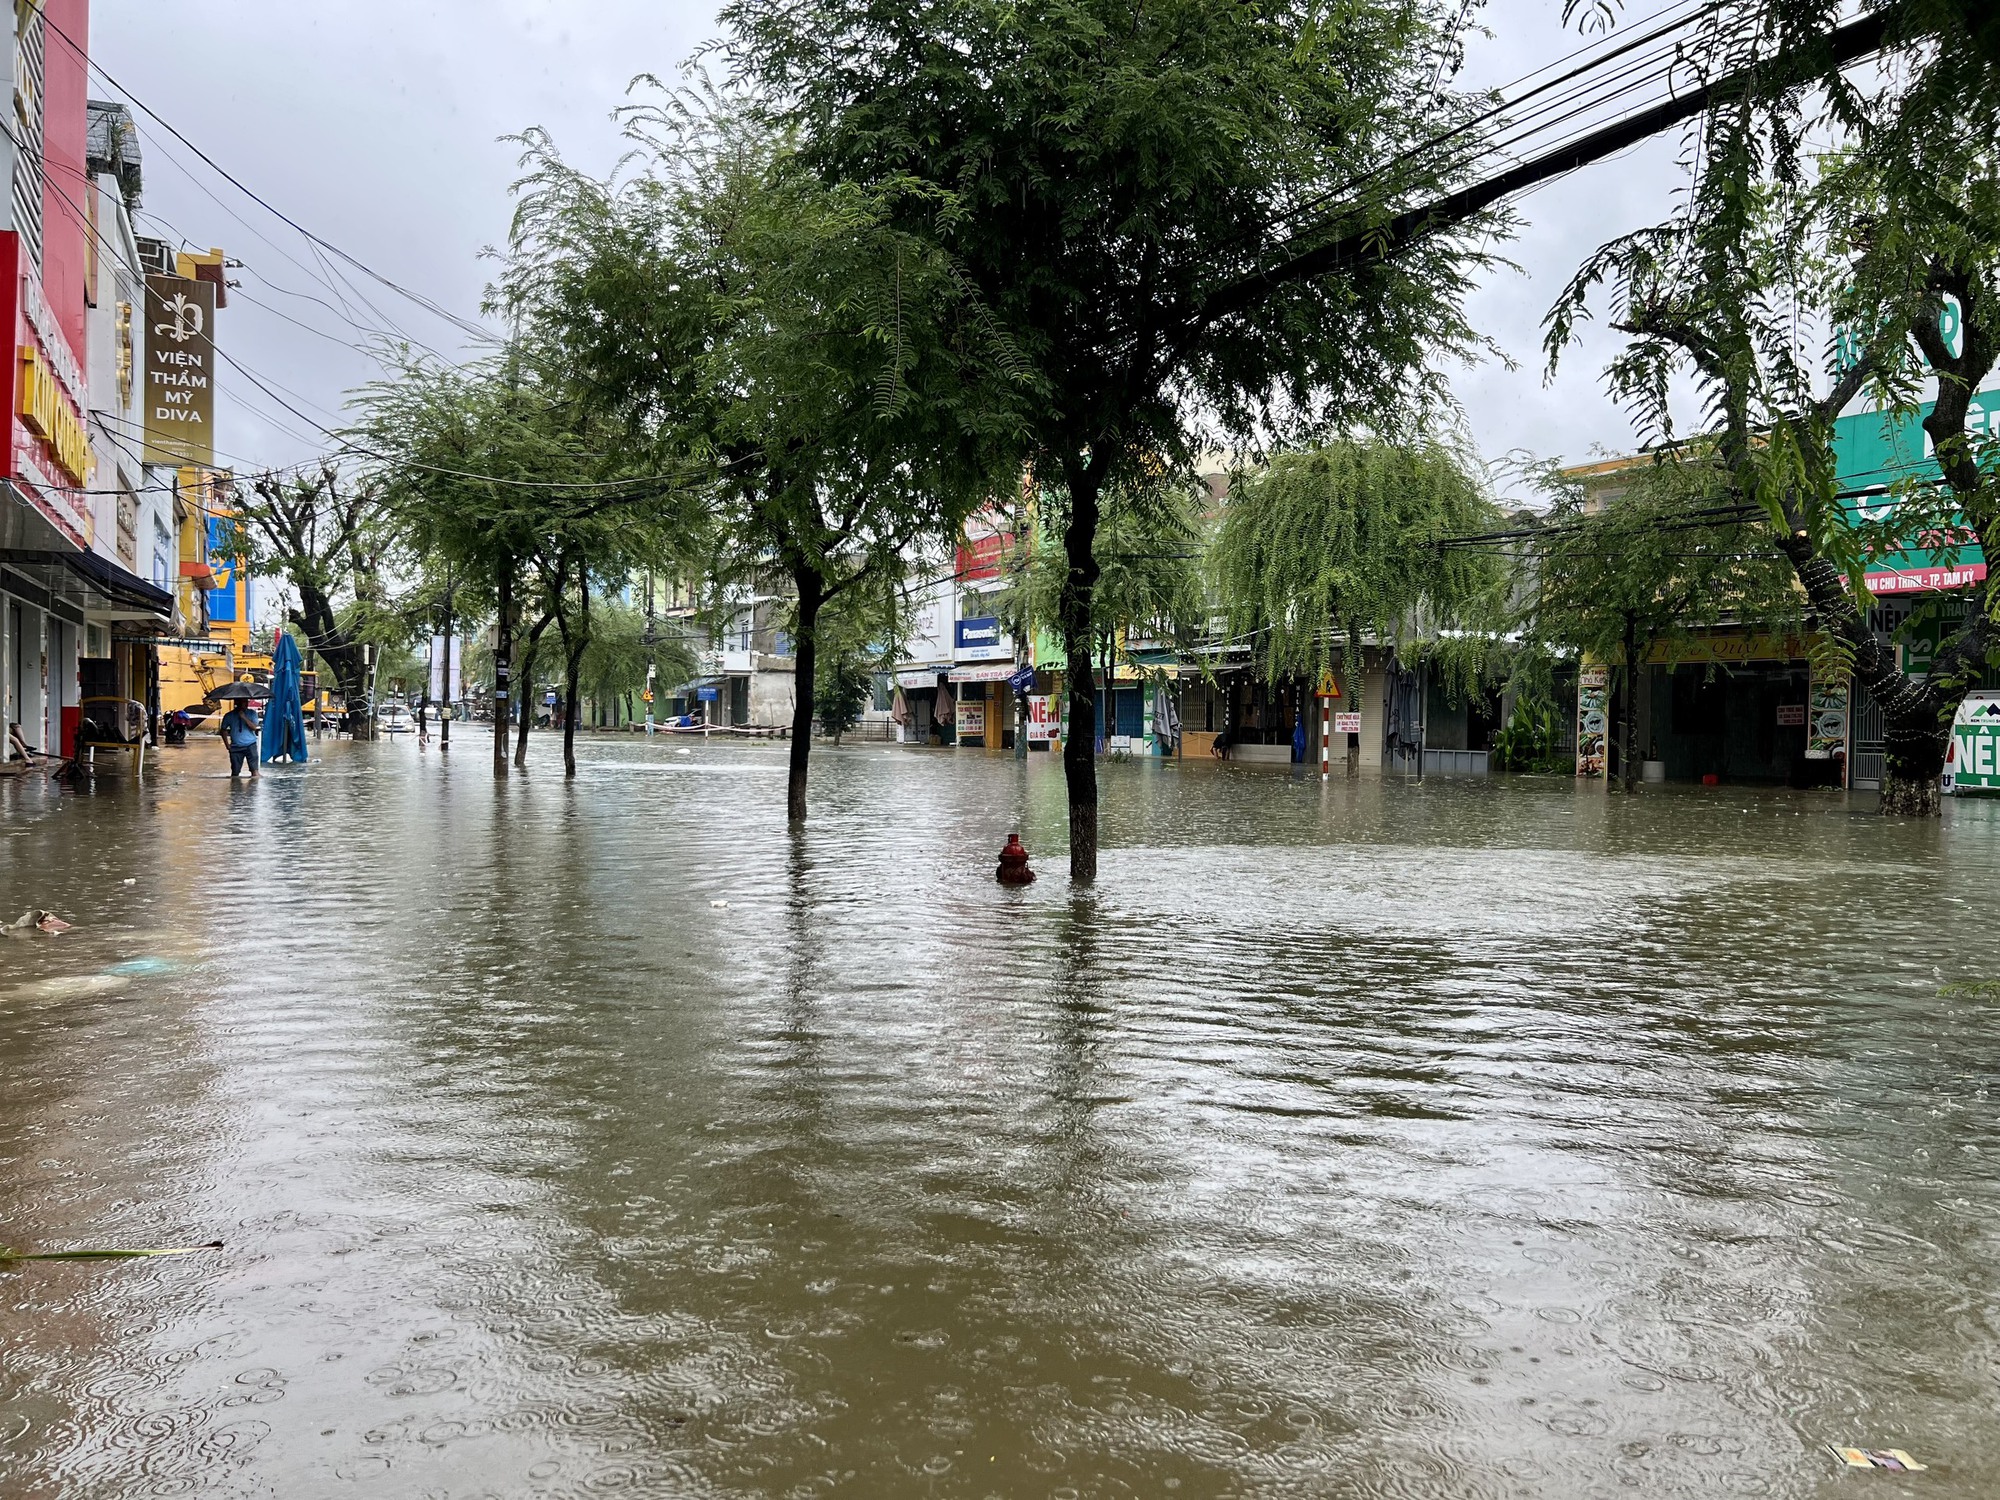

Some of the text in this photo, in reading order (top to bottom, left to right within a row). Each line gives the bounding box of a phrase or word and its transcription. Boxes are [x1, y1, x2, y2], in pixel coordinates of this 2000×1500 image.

[155, 350, 202, 368] VIỆN
[150, 369, 207, 388] THẨM
[165, 390, 194, 404] MỸ
[156, 407, 203, 423] DIVA
[1880, 577, 1896, 591] CHU
[1929, 573, 1942, 587] TP.
[1943, 571, 1960, 586] TAM
[1962, 568, 1975, 584] KỲ
[1955, 725, 2000, 787] NỆ
